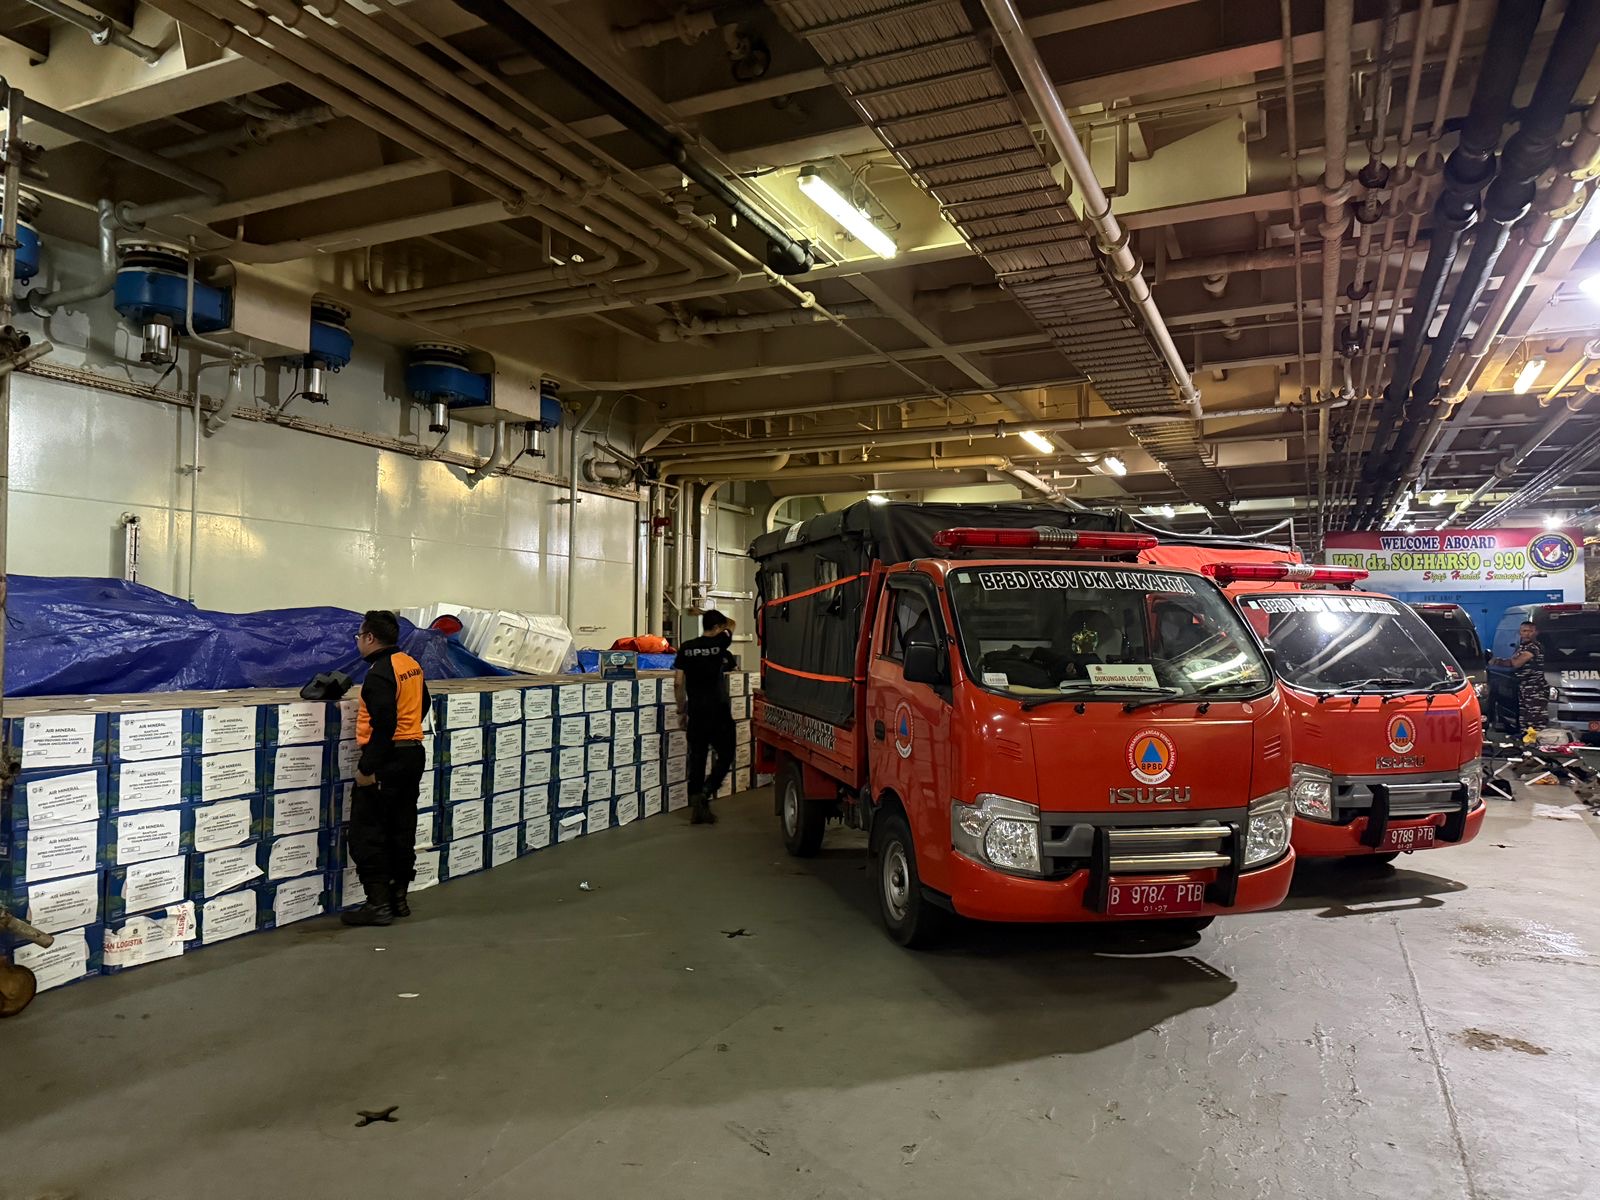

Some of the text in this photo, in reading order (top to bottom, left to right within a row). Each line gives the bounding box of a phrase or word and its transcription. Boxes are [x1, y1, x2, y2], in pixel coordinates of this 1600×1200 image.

[1380, 536, 1496, 550] WELCOME ABOARD
[1333, 553, 1364, 568] KRI
[1391, 552, 1480, 570] SOEHARSO
[1494, 552, 1525, 570] 990
[978, 570, 1196, 594] BPBD PROV DKI JAKARTA
[1258, 598, 1296, 614] BPBD
[1425, 716, 1462, 743] 112
[1376, 756, 1424, 769] ISUZU
[1109, 786, 1191, 804] ISUZU
[1392, 828, 1434, 844] 9789 PTB
[1110, 886, 1120, 905] B
[1176, 884, 1202, 902] PTB
[116, 938, 144, 949] LOGISTIK
